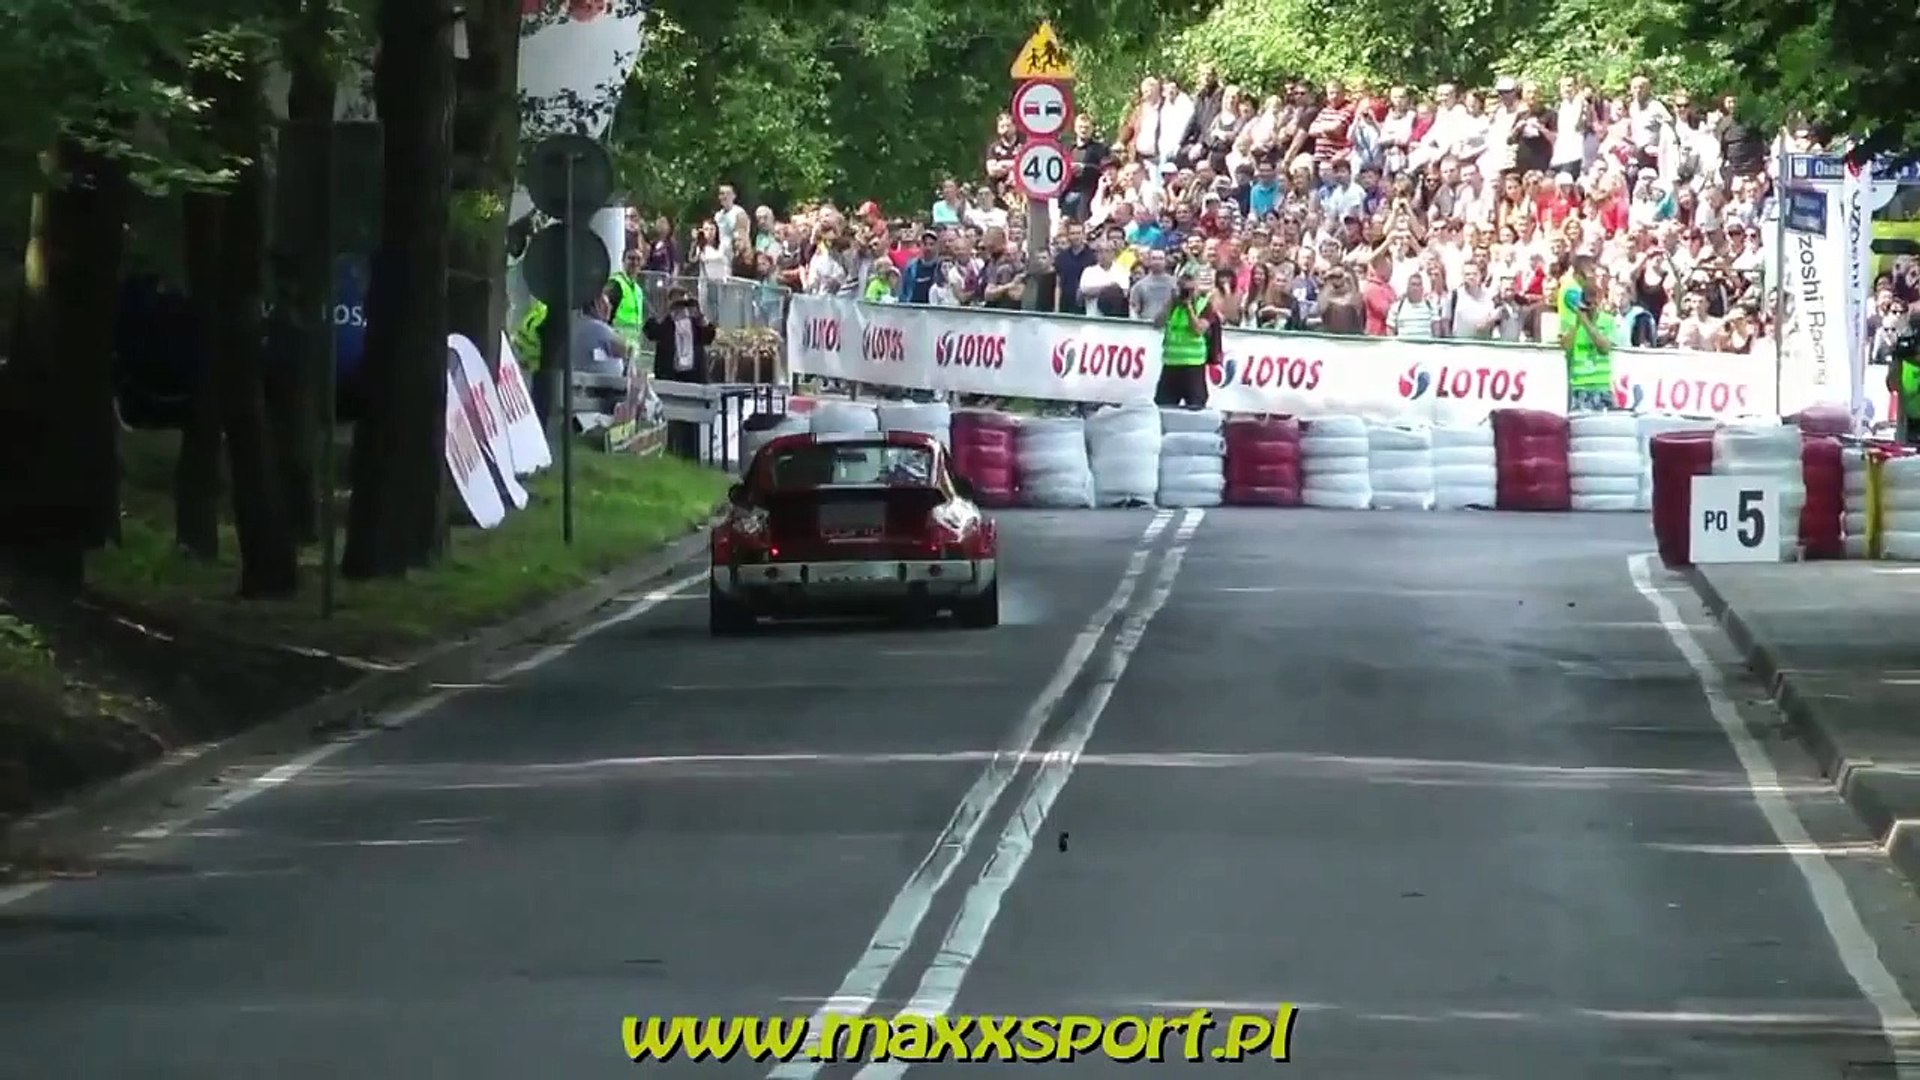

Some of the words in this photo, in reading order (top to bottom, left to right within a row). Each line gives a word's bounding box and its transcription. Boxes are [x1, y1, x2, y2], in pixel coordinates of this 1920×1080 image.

[1024, 156, 1063, 183] 40
[1798, 235, 1826, 303] zoshi
[954, 334, 1006, 369] LOTOS
[1079, 342, 1146, 379] LOTOS
[1241, 355, 1323, 390] LOTOS
[1436, 366, 1527, 402] LOTOS
[1655, 378, 1748, 413] LOTOS
[1704, 510, 1728, 532] PO
[1737, 490, 1765, 548] 5
